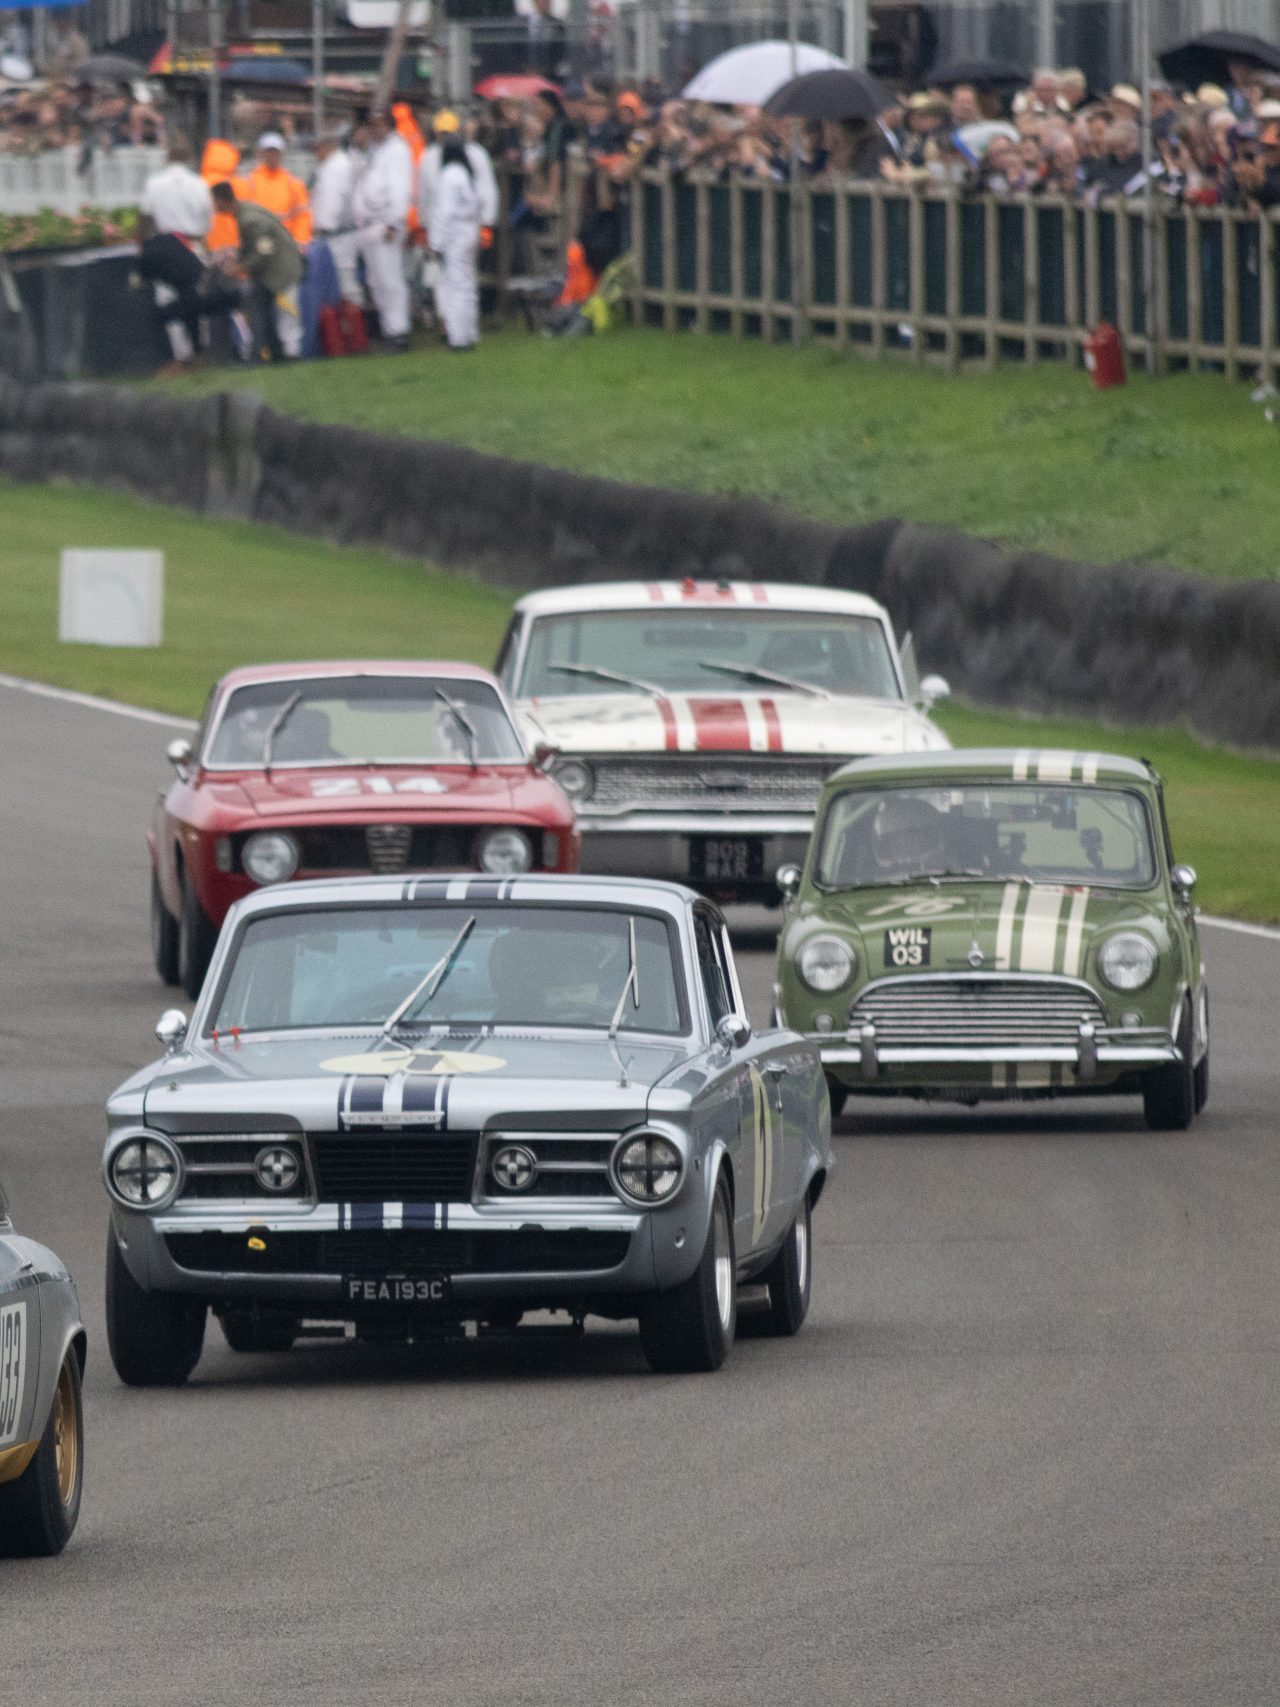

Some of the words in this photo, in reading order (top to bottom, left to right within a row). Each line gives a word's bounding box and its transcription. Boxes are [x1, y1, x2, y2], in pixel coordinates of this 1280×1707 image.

[309, 776, 449, 798] 214
[888, 929, 929, 945] WIL
[348, 1280, 443, 1300] FEA193C
